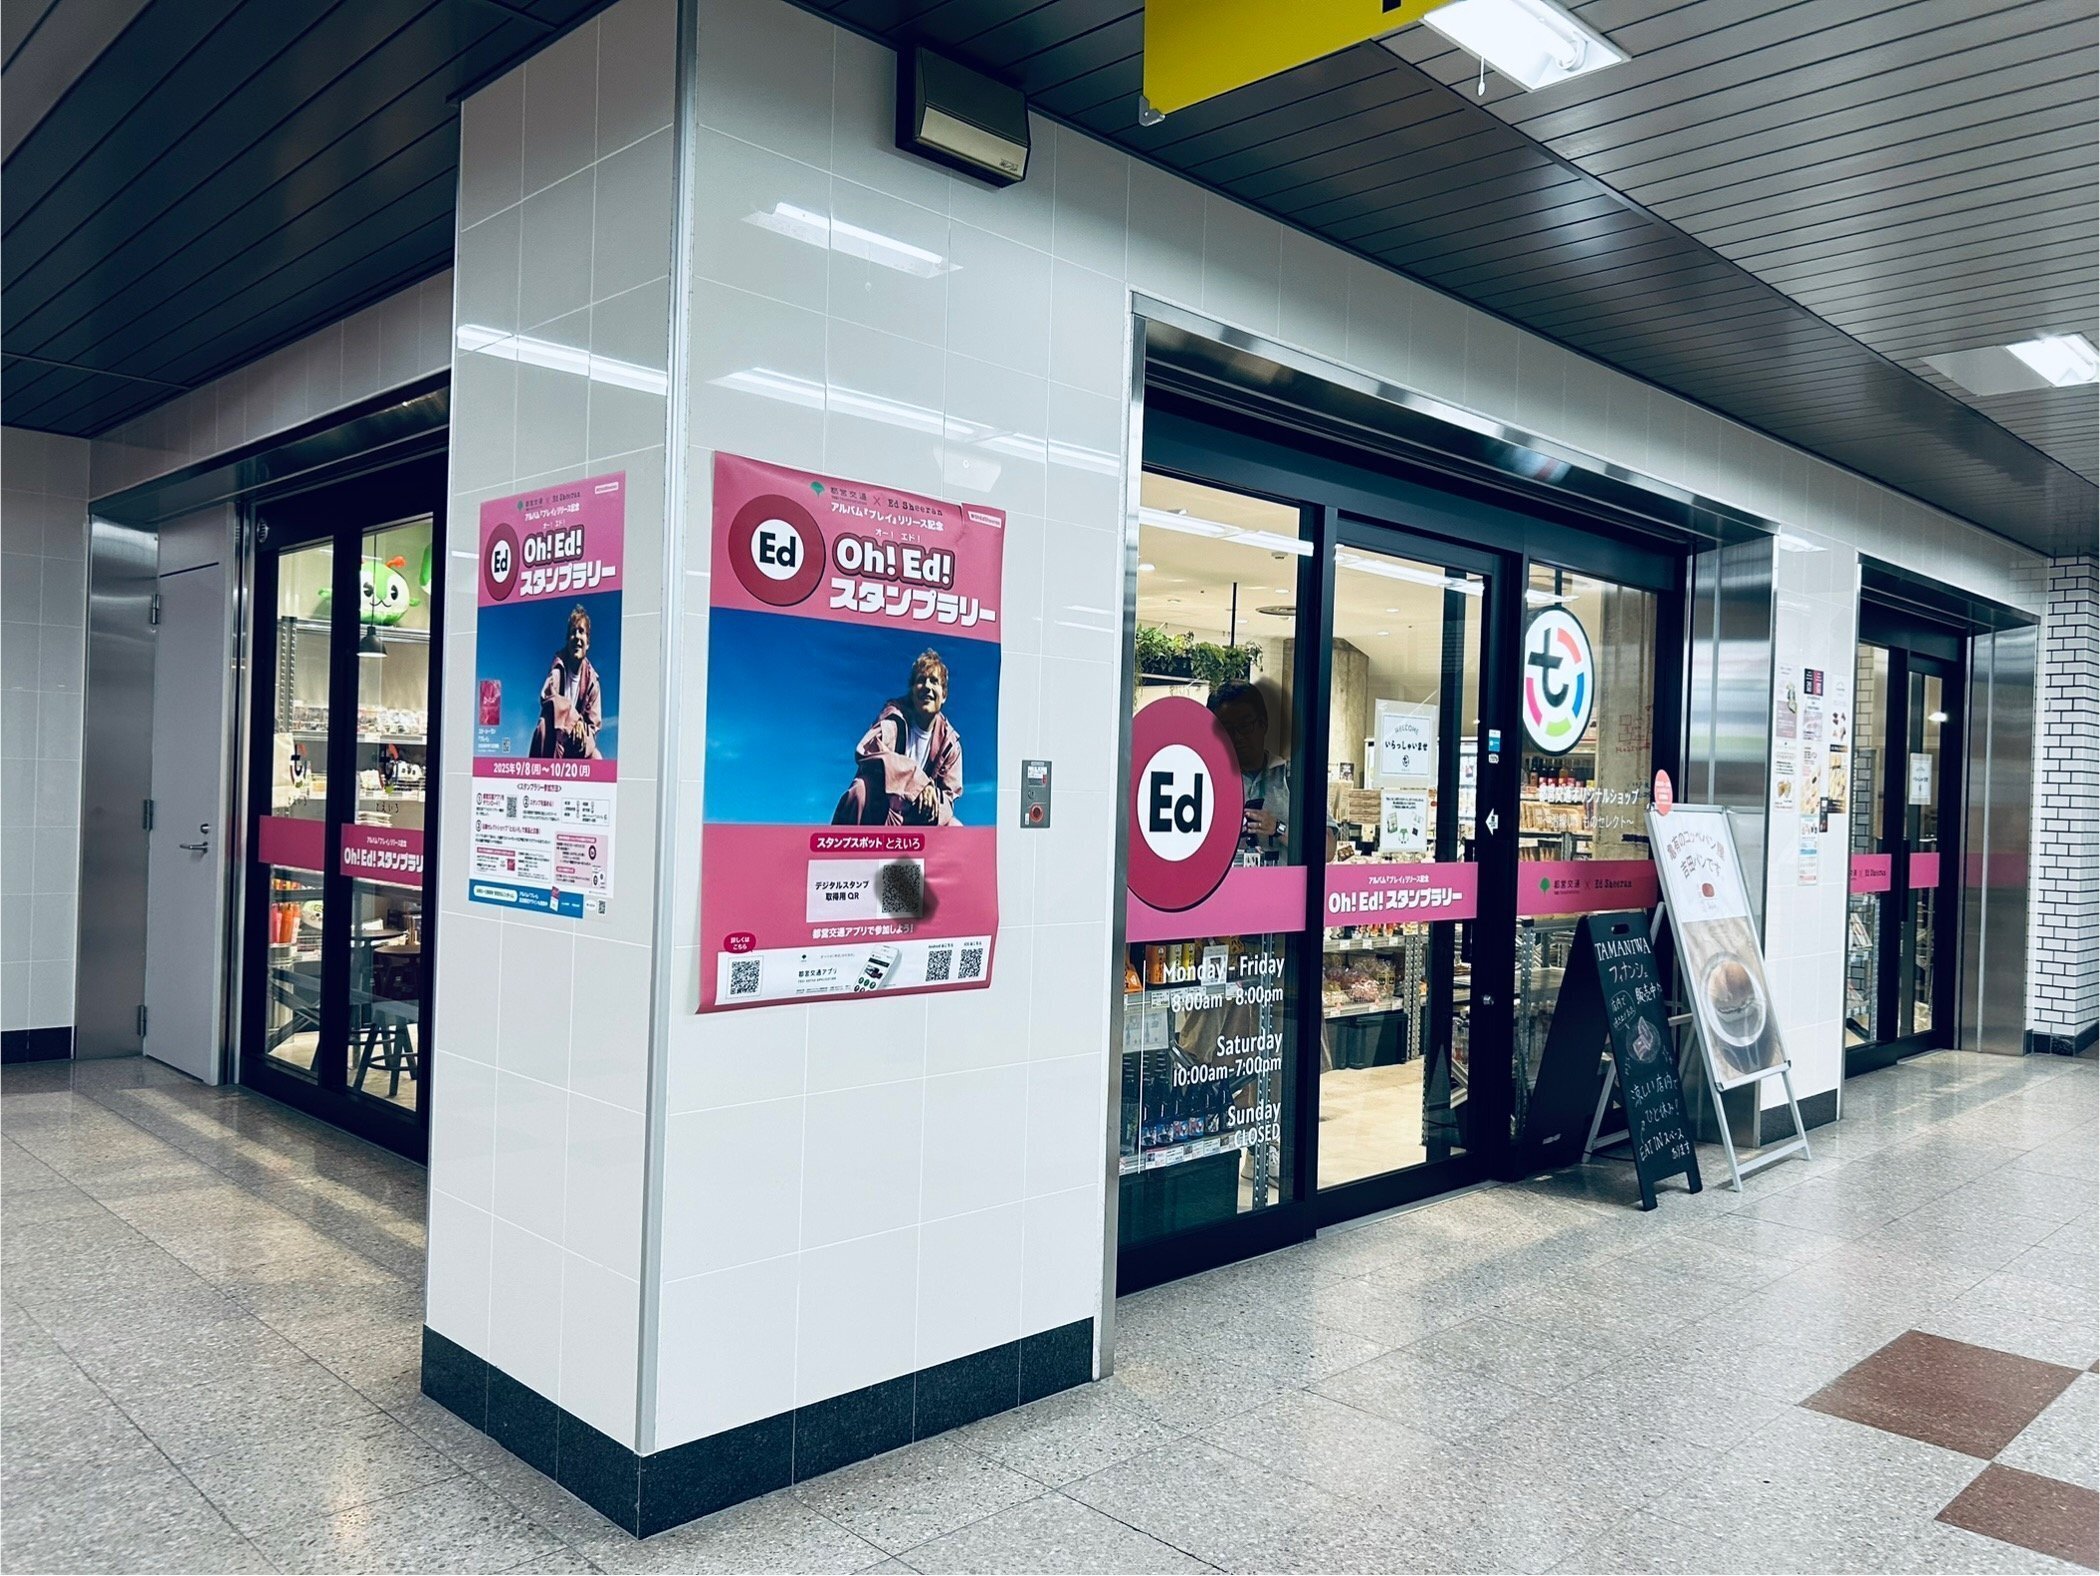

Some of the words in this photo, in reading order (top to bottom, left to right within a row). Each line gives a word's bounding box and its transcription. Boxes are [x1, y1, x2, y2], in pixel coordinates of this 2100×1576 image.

[888, 499, 899, 509] Ed
[902, 502, 943, 516] Sheeran
[524, 535, 552, 562] Oh!
[554, 529, 581, 559] Ed!
[759, 531, 797, 568] Ed
[494, 549, 509, 573] Ed
[836, 538, 896, 576] Oh!
[902, 548, 951, 584] Ed!
[520, 560, 616, 597] スタンプラリー
[829, 577, 997, 627] スタンプラリー
[1385, 740, 1428, 751] いらっしゃいませ
[1149, 771, 1204, 835] Ed
[816, 837, 883, 849] スタンプスポット
[885, 837, 921, 850] とえいろ
[344, 847, 360, 866] Oh!
[361, 849, 376, 868] Ed!
[815, 880, 870, 890] デジタルスタンプ
[848, 891, 860, 900] QR
[1328, 892, 1357, 914] Oh!
[1359, 890, 1384, 912] Ed!
[1386, 887, 1463, 910] スタンプラリー
[1594, 937, 1652, 962] TAMANIWA
[1162, 960, 1228, 984] Monday
[1240, 952, 1285, 977] Friday
[1171, 991, 1223, 1012] 8:00am
[1236, 985, 1283, 1007] 8:00pm
[1217, 1028, 1283, 1056] Saturday
[1173, 1056, 1282, 1087] 10:00am-7:00pm
[1227, 1098, 1281, 1126] Sunday
[1234, 1122, 1281, 1149] CLOSED
